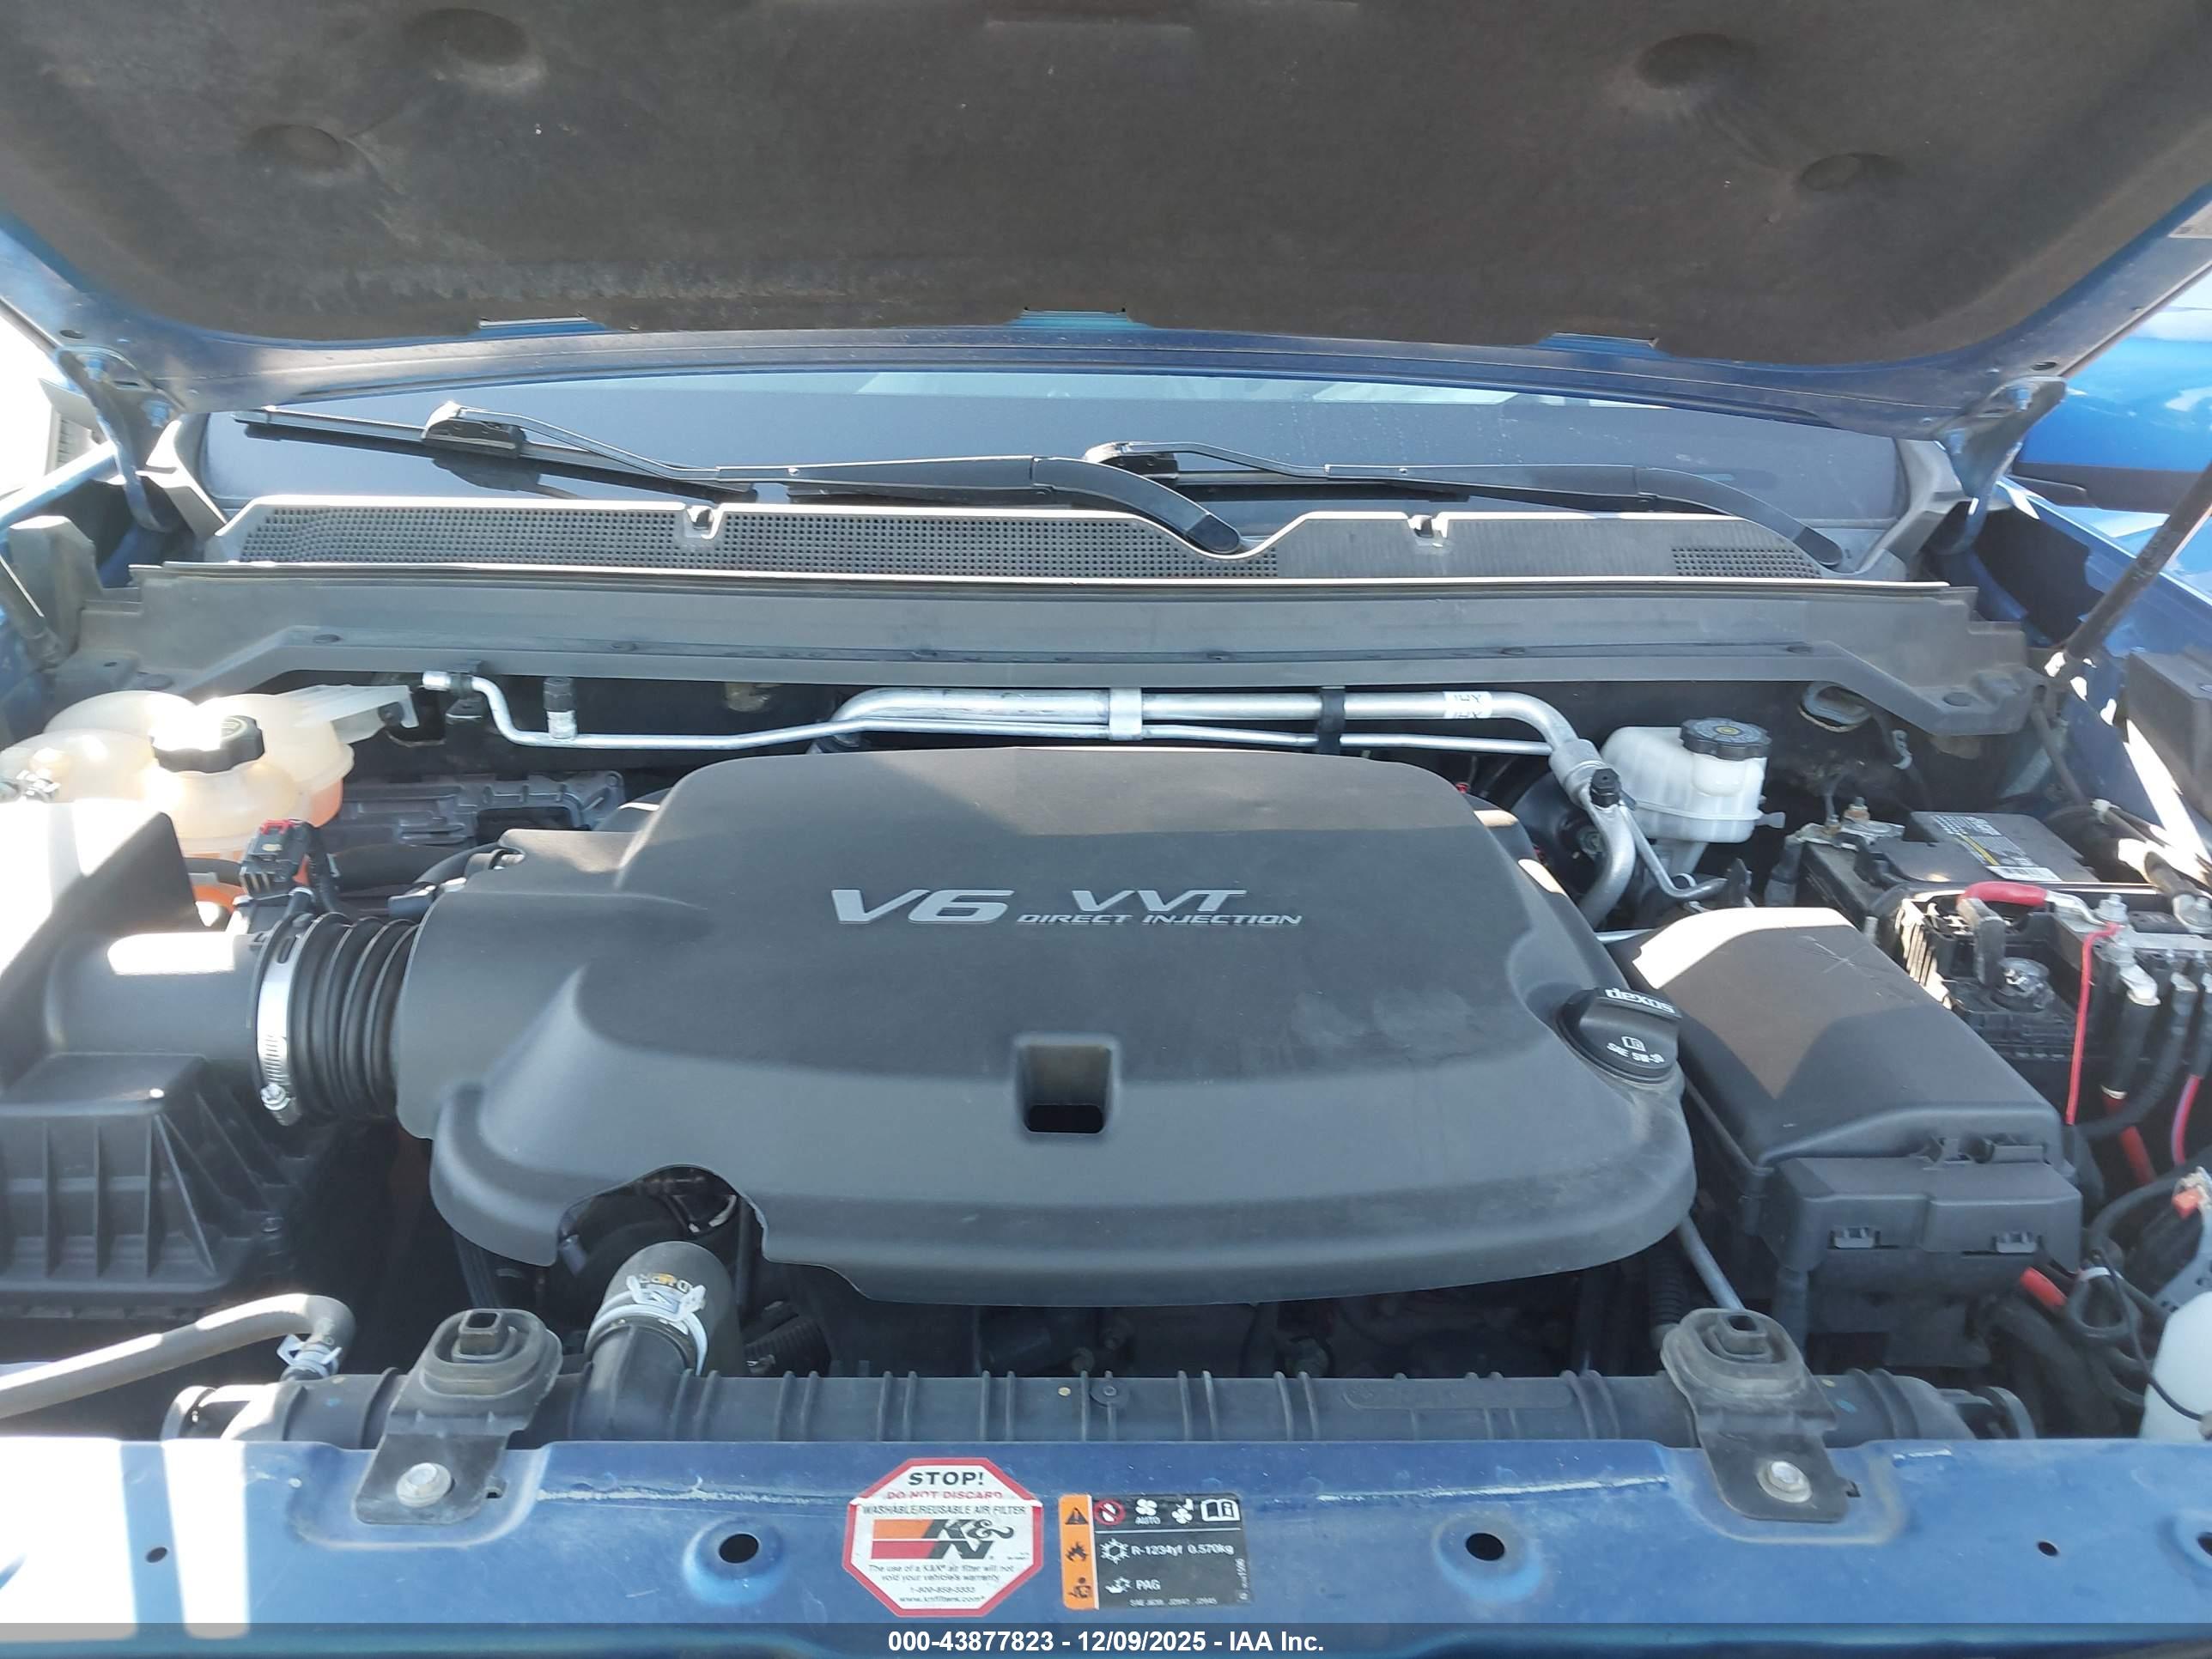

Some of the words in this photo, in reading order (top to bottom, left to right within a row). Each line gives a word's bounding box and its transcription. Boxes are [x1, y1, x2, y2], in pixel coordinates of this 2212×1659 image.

[831, 889, 1016, 924] V6
[1072, 890, 1247, 912] VVT
[1017, 914, 1133, 925] DIRECT
[1141, 915, 1303, 926] INJECTION
[908, 1471, 984, 1486] STOP!
[885, 1491, 904, 1500] DO
[910, 1491, 939, 1500] NOT
[943, 1491, 1003, 1500] DISCARD
[974, 1505, 990, 1515] AIR
[993, 1505, 1026, 1515] FILTER
[1135, 1516, 1160, 1525] AUTO
[921, 1519, 1014, 1559] K&N
[1131, 1545, 1183, 1557] R-1234yf
[1136, 1579, 1161, 1591] PAG
